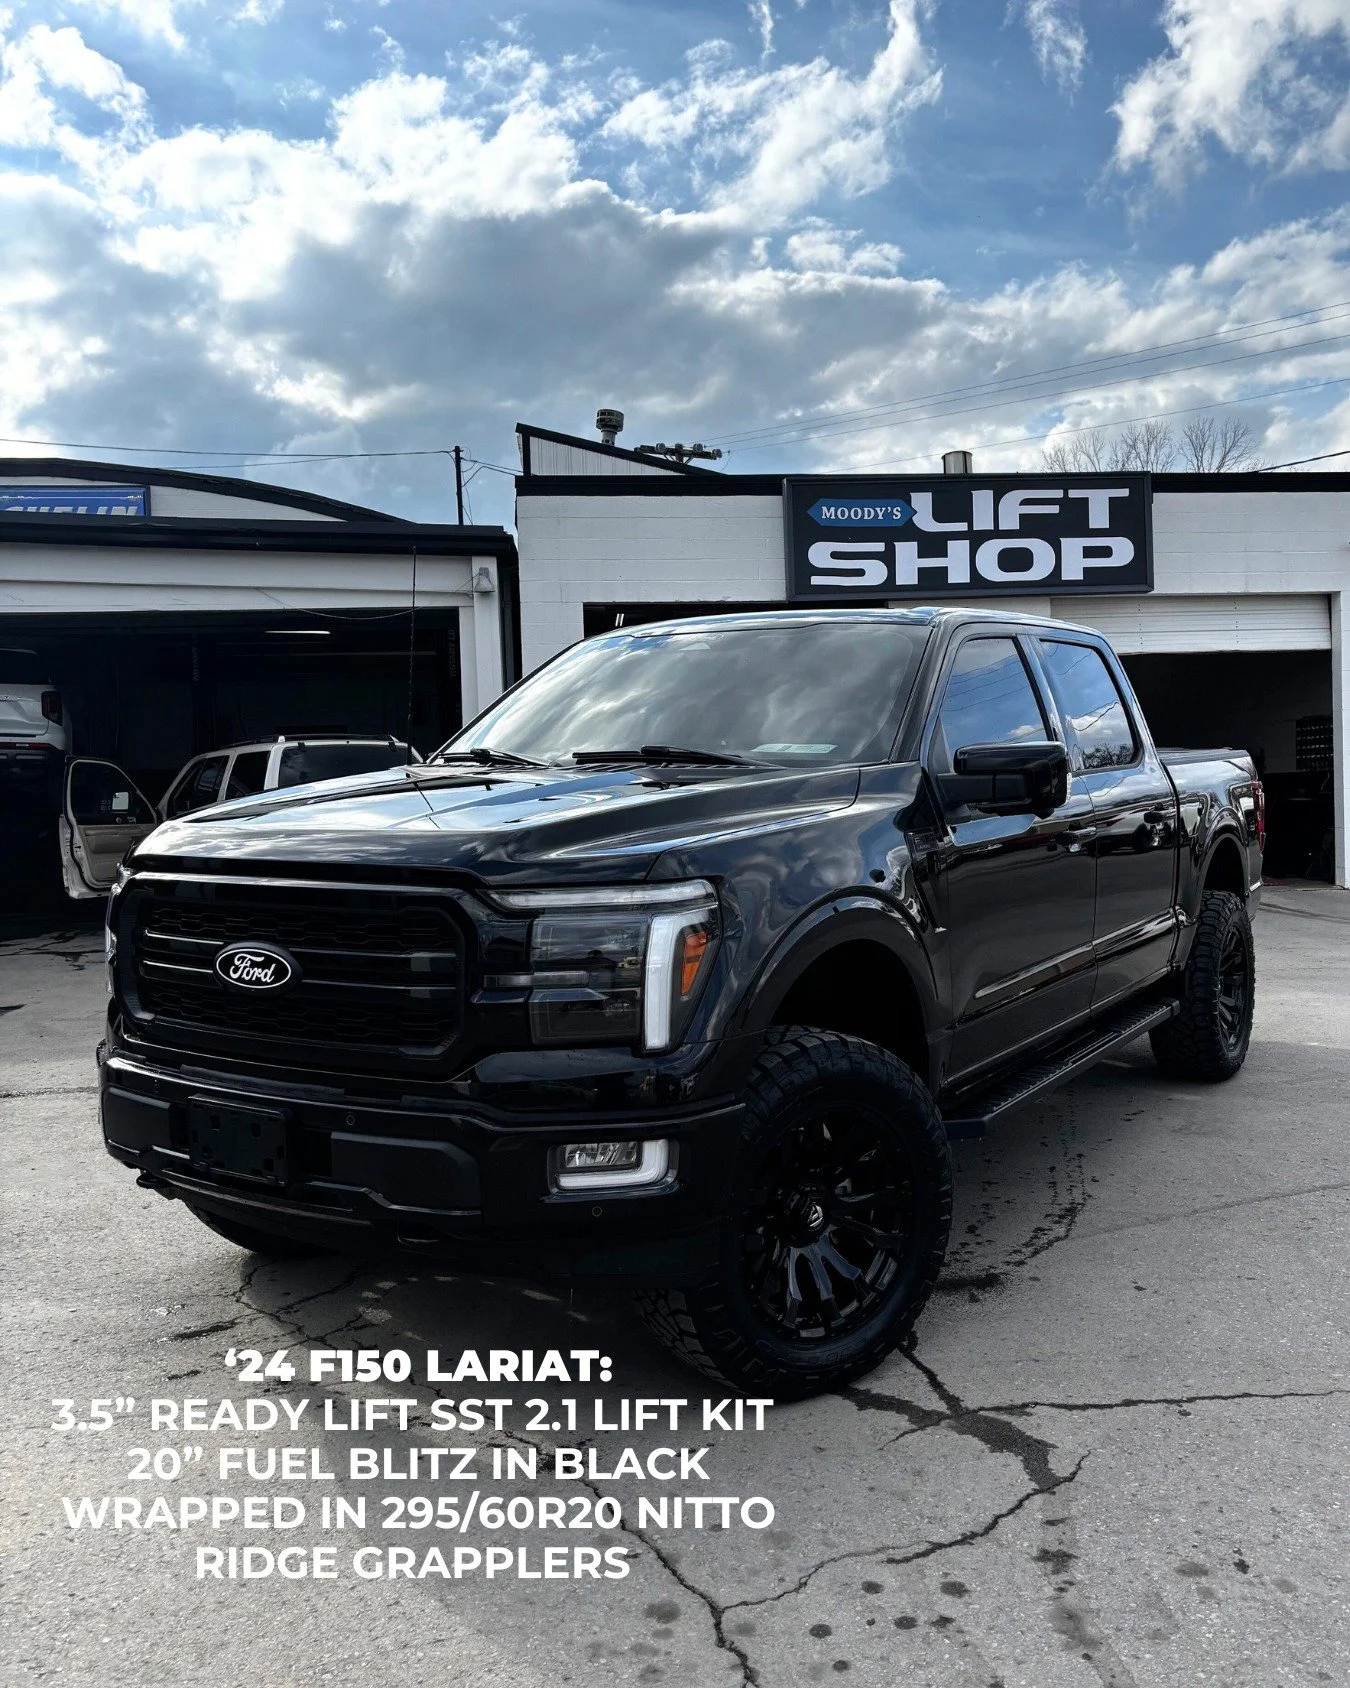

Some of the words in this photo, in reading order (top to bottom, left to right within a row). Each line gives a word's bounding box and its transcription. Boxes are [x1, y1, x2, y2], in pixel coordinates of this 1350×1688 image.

[821, 505, 902, 521] MOODY’S
[910, 488, 1130, 532] LIFT
[807, 536, 1135, 586] SHOP
[229, 953, 276, 983] Ford
